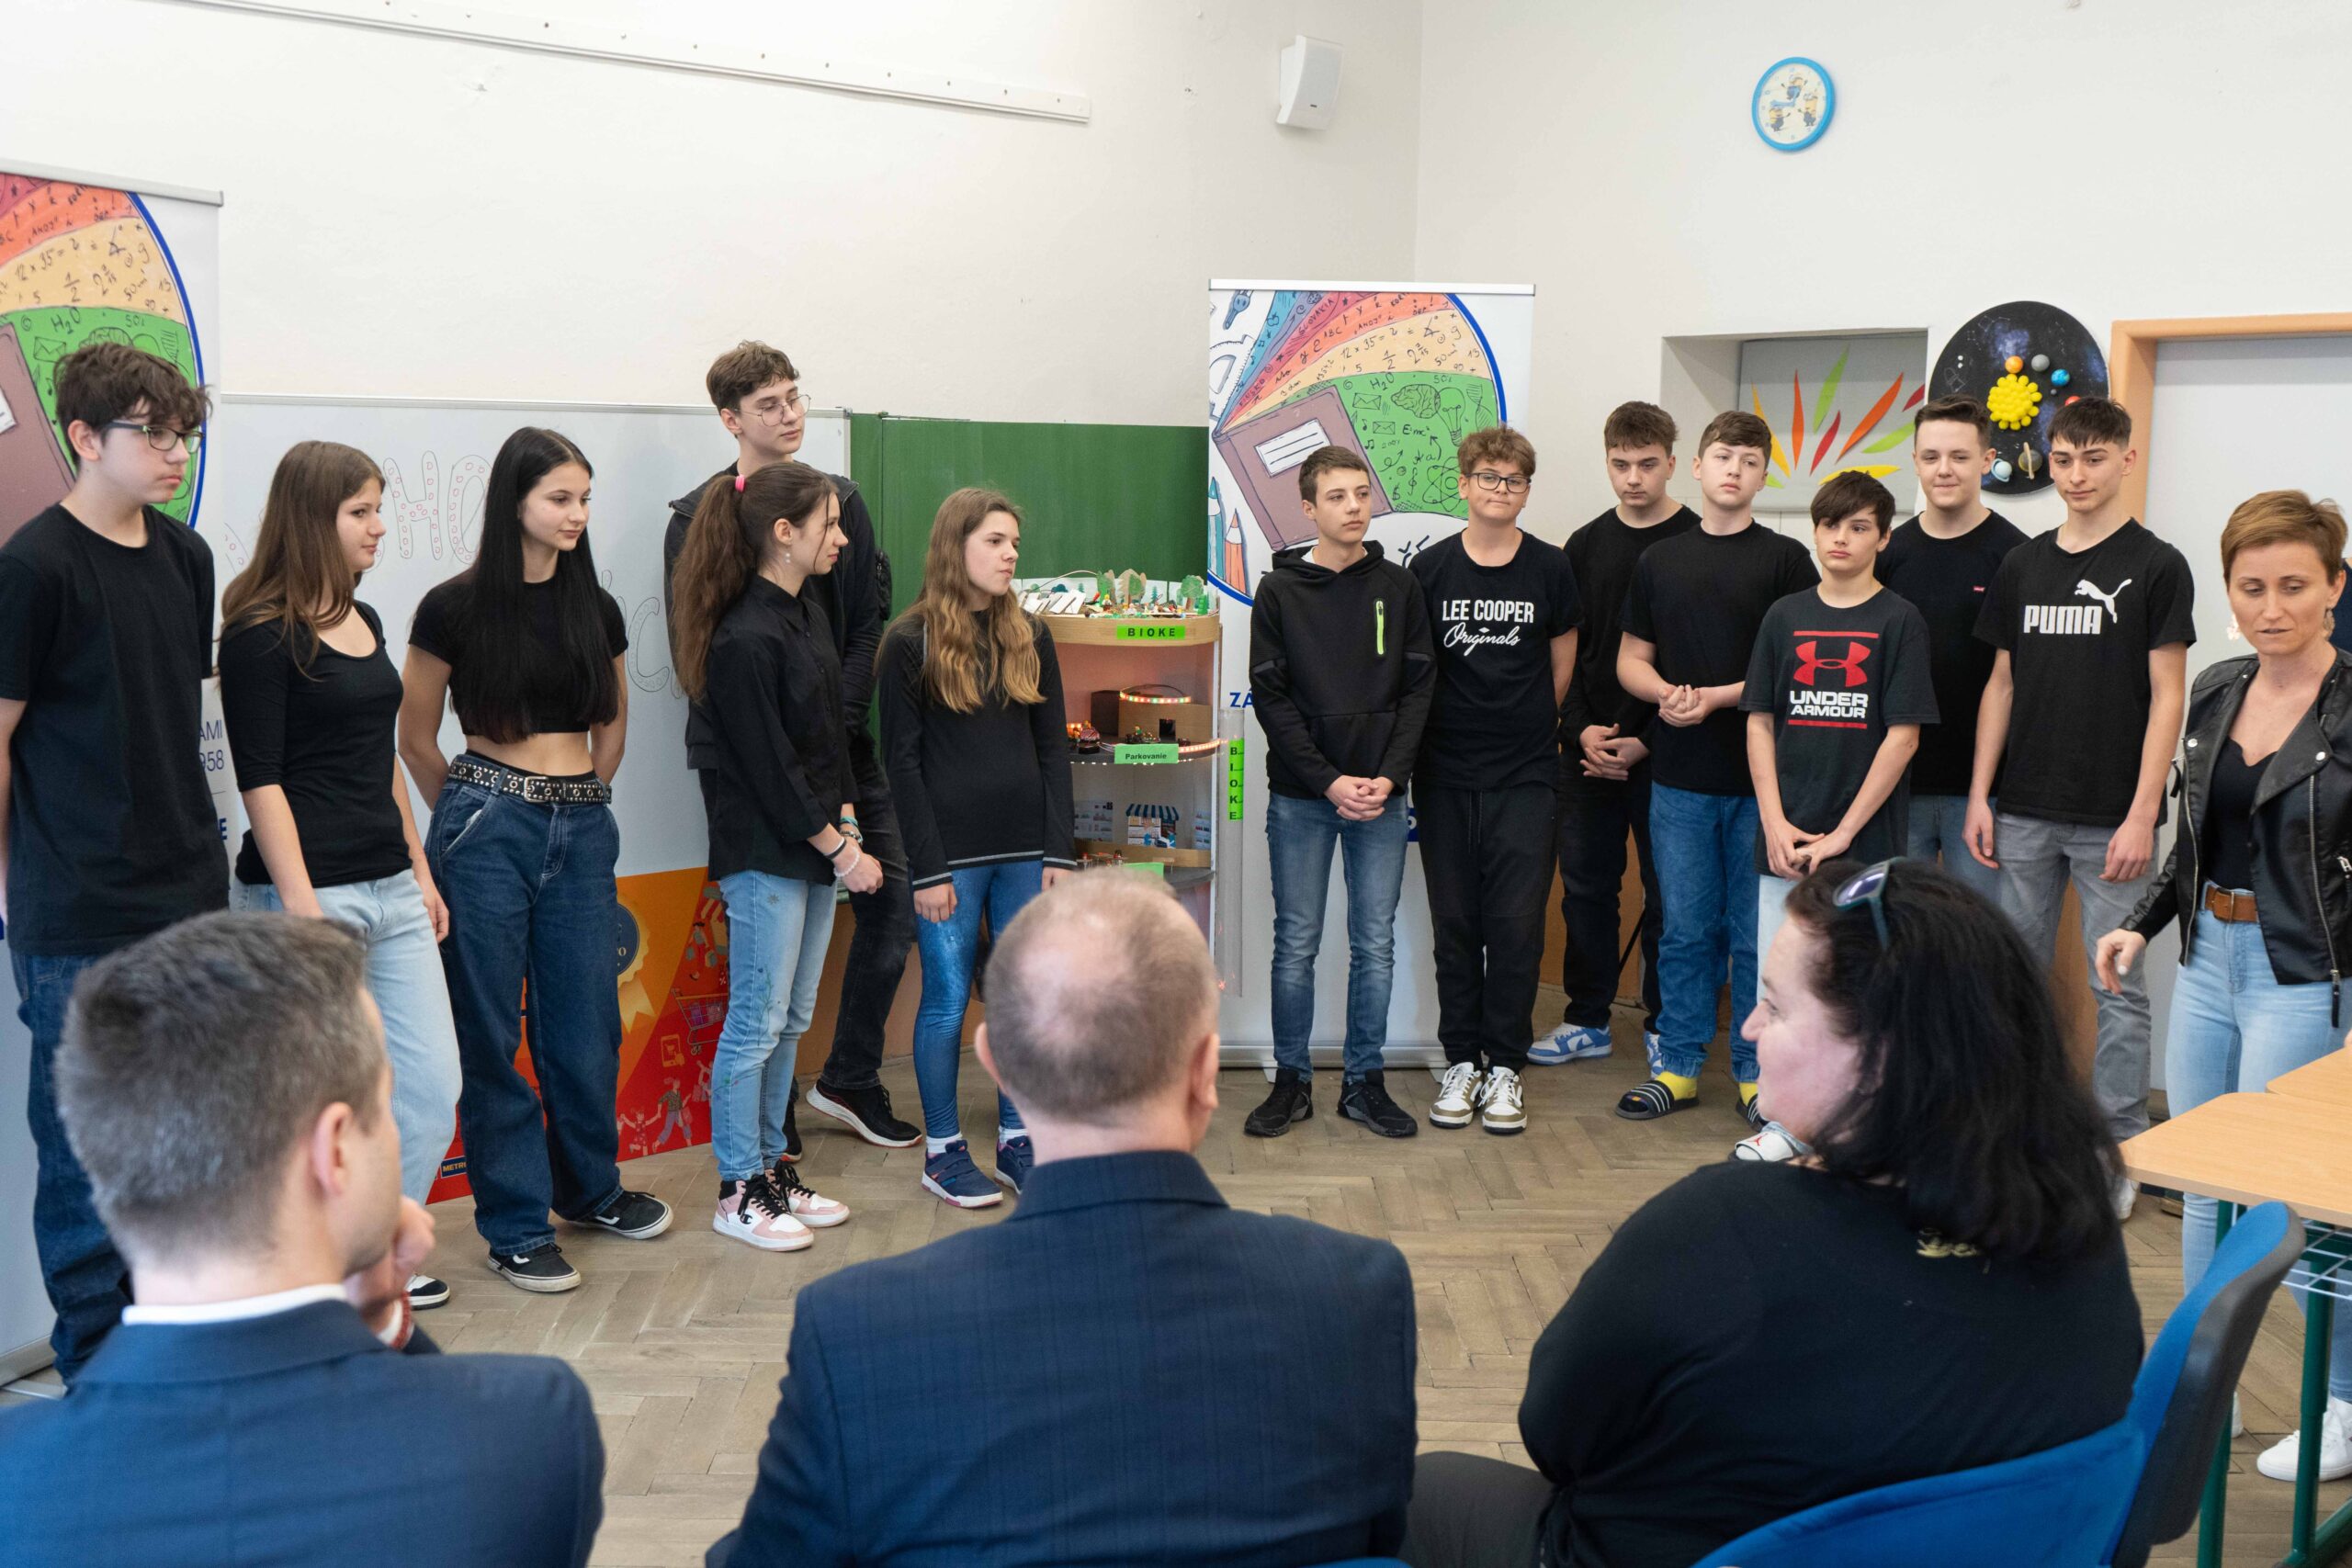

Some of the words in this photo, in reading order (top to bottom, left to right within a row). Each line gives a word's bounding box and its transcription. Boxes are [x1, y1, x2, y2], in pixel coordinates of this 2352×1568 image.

[1298, 298, 1334, 336] SLOVAKIA
[1442, 600, 1471, 621] LEE
[1474, 599, 1534, 623] COOPER
[2023, 604, 2102, 635] PUMA
[1443, 622, 1521, 656] Originals
[1229, 689, 1254, 708] ZÁ
[1790, 690, 1869, 707] UNDER
[1791, 705, 1866, 718] ARMOUR
[199, 719, 222, 741] AMI
[1125, 751, 1167, 761] Parkovanie
[442, 1161, 467, 1172] METR
